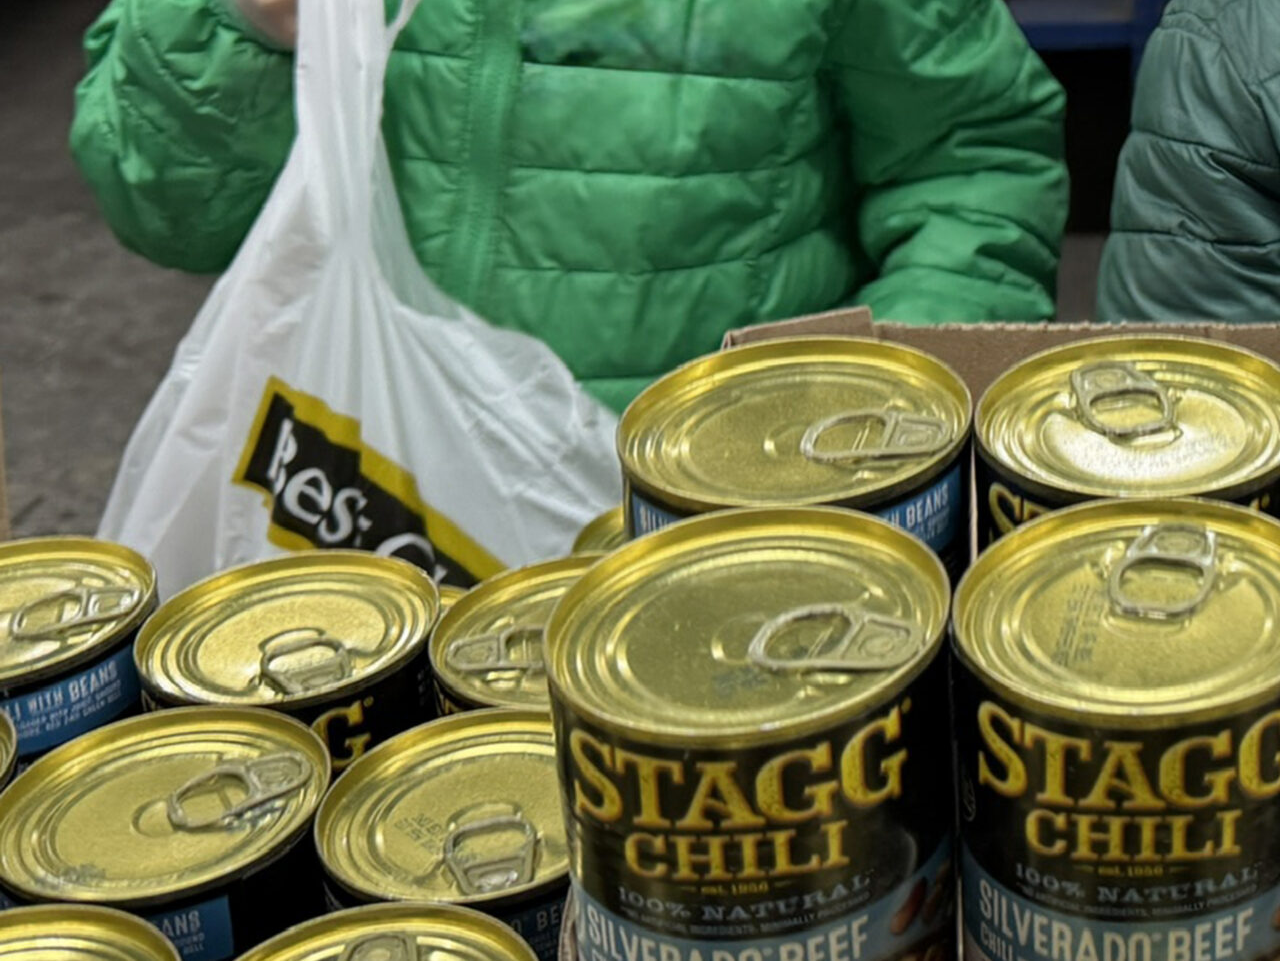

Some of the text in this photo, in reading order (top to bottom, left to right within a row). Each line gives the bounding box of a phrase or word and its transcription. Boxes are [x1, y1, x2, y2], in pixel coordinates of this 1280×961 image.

[67, 659, 119, 704] BEANS
[569, 704, 908, 830] STAGG
[623, 818, 851, 882] CHILI
[1024, 808, 1243, 862] CHILI
[617, 886, 693, 919] 100%
[1015, 862, 1086, 899] 100%
